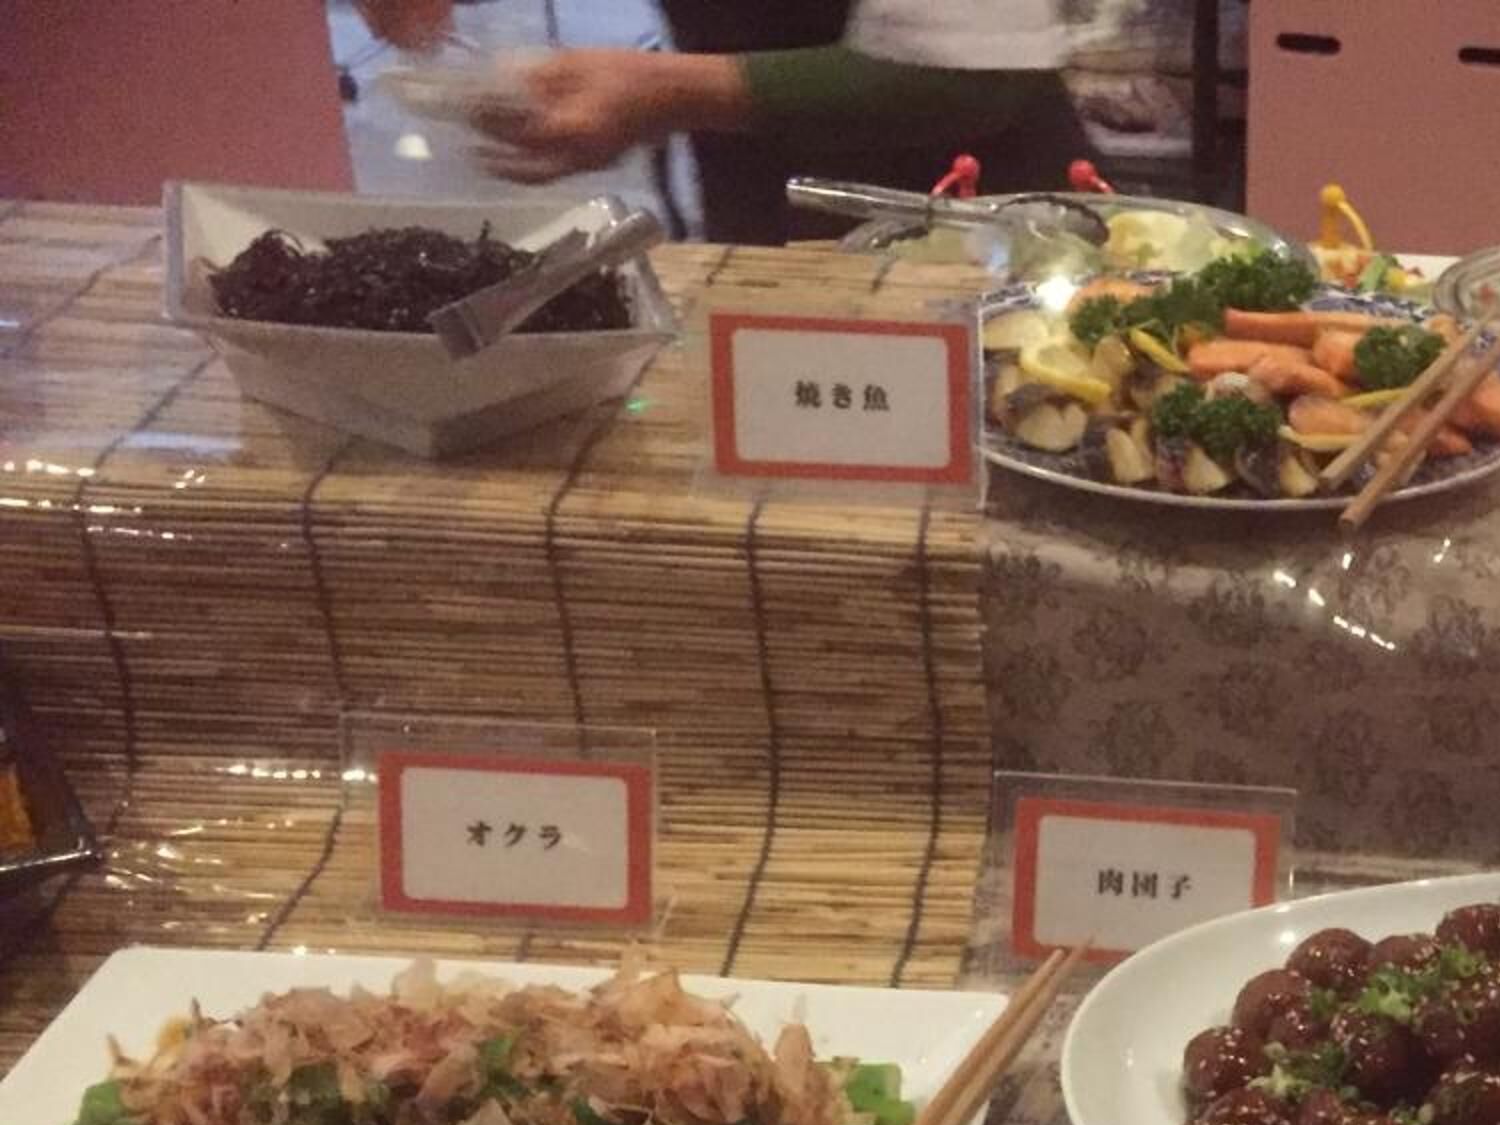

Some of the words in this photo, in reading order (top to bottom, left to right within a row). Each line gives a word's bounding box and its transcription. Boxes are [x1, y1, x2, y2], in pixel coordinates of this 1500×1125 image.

[794, 380, 890, 412] 焼き魚
[466, 819, 562, 850] オクラ
[1097, 867, 1192, 900] 肉団子
